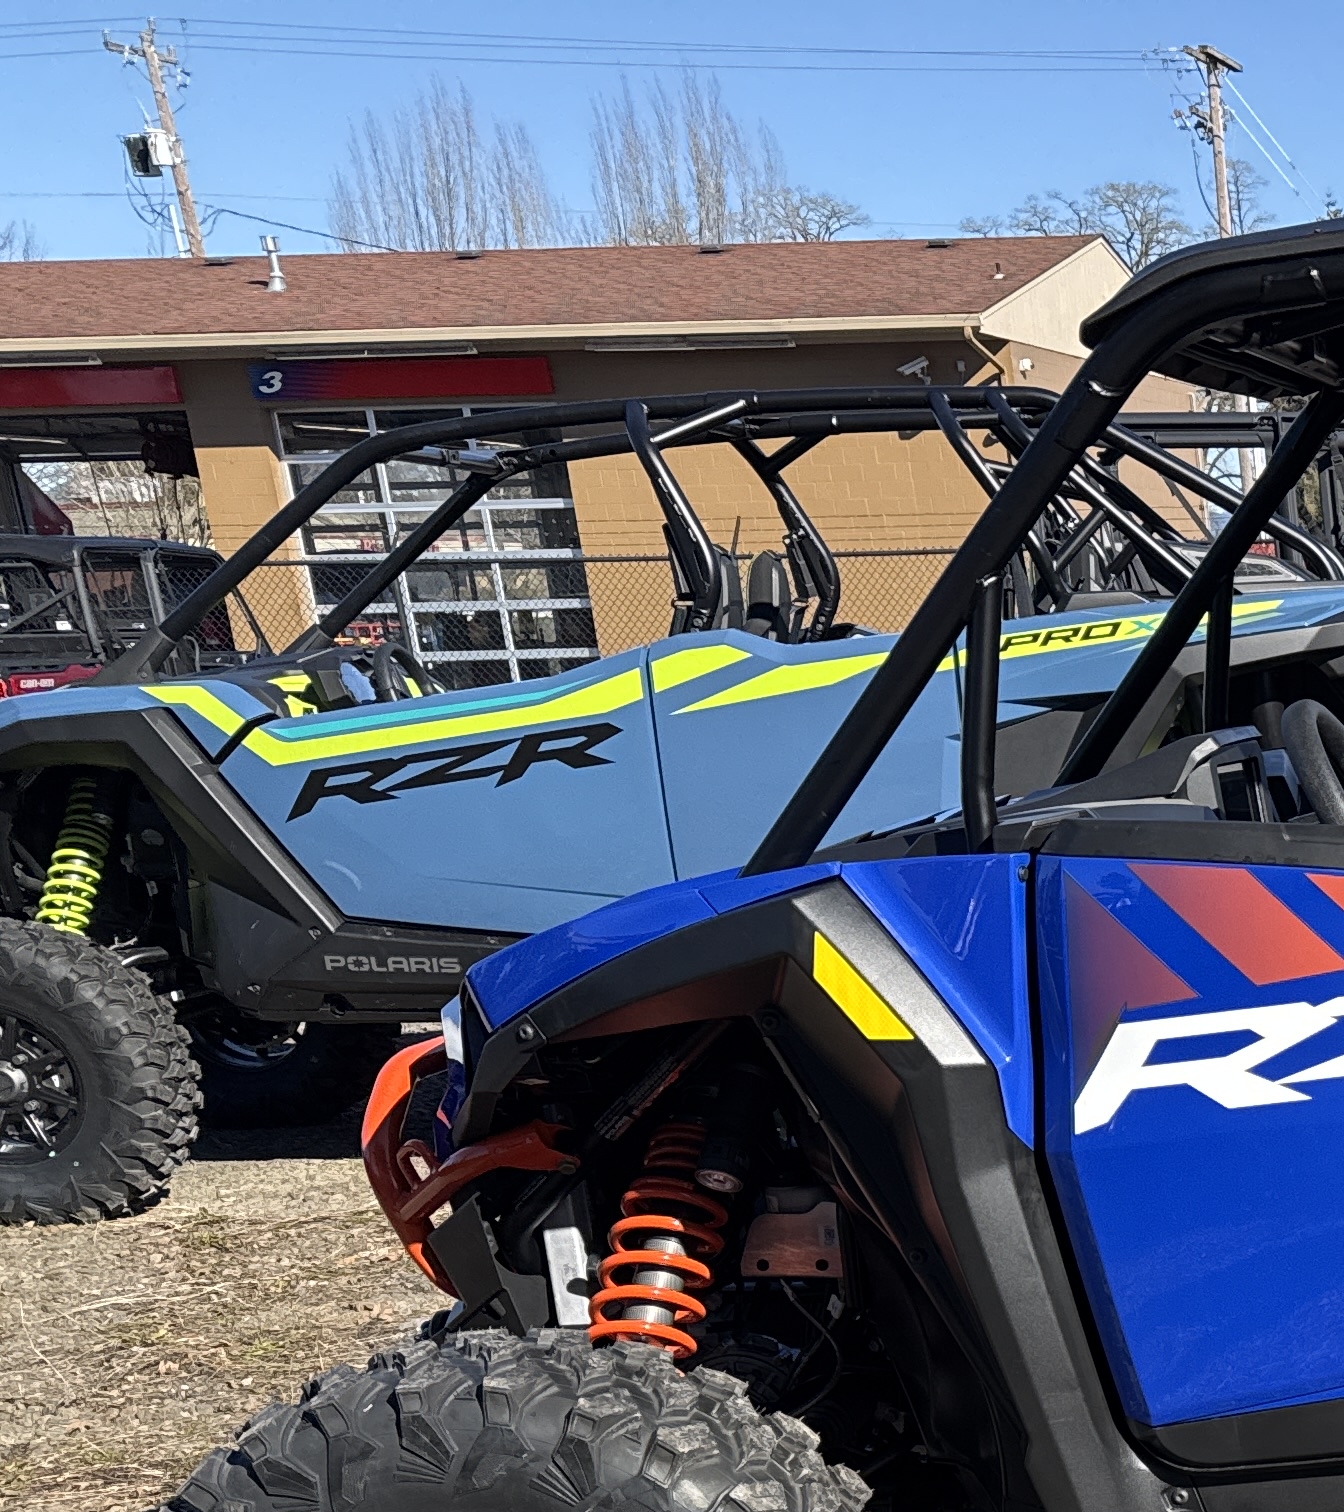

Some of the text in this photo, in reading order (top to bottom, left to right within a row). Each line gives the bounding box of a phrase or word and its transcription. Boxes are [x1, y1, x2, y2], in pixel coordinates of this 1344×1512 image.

[258, 371, 283, 394] 3
[1000, 622, 1123, 652] PRO
[286, 722, 623, 822] RZR
[324, 954, 463, 974] POLARIS
